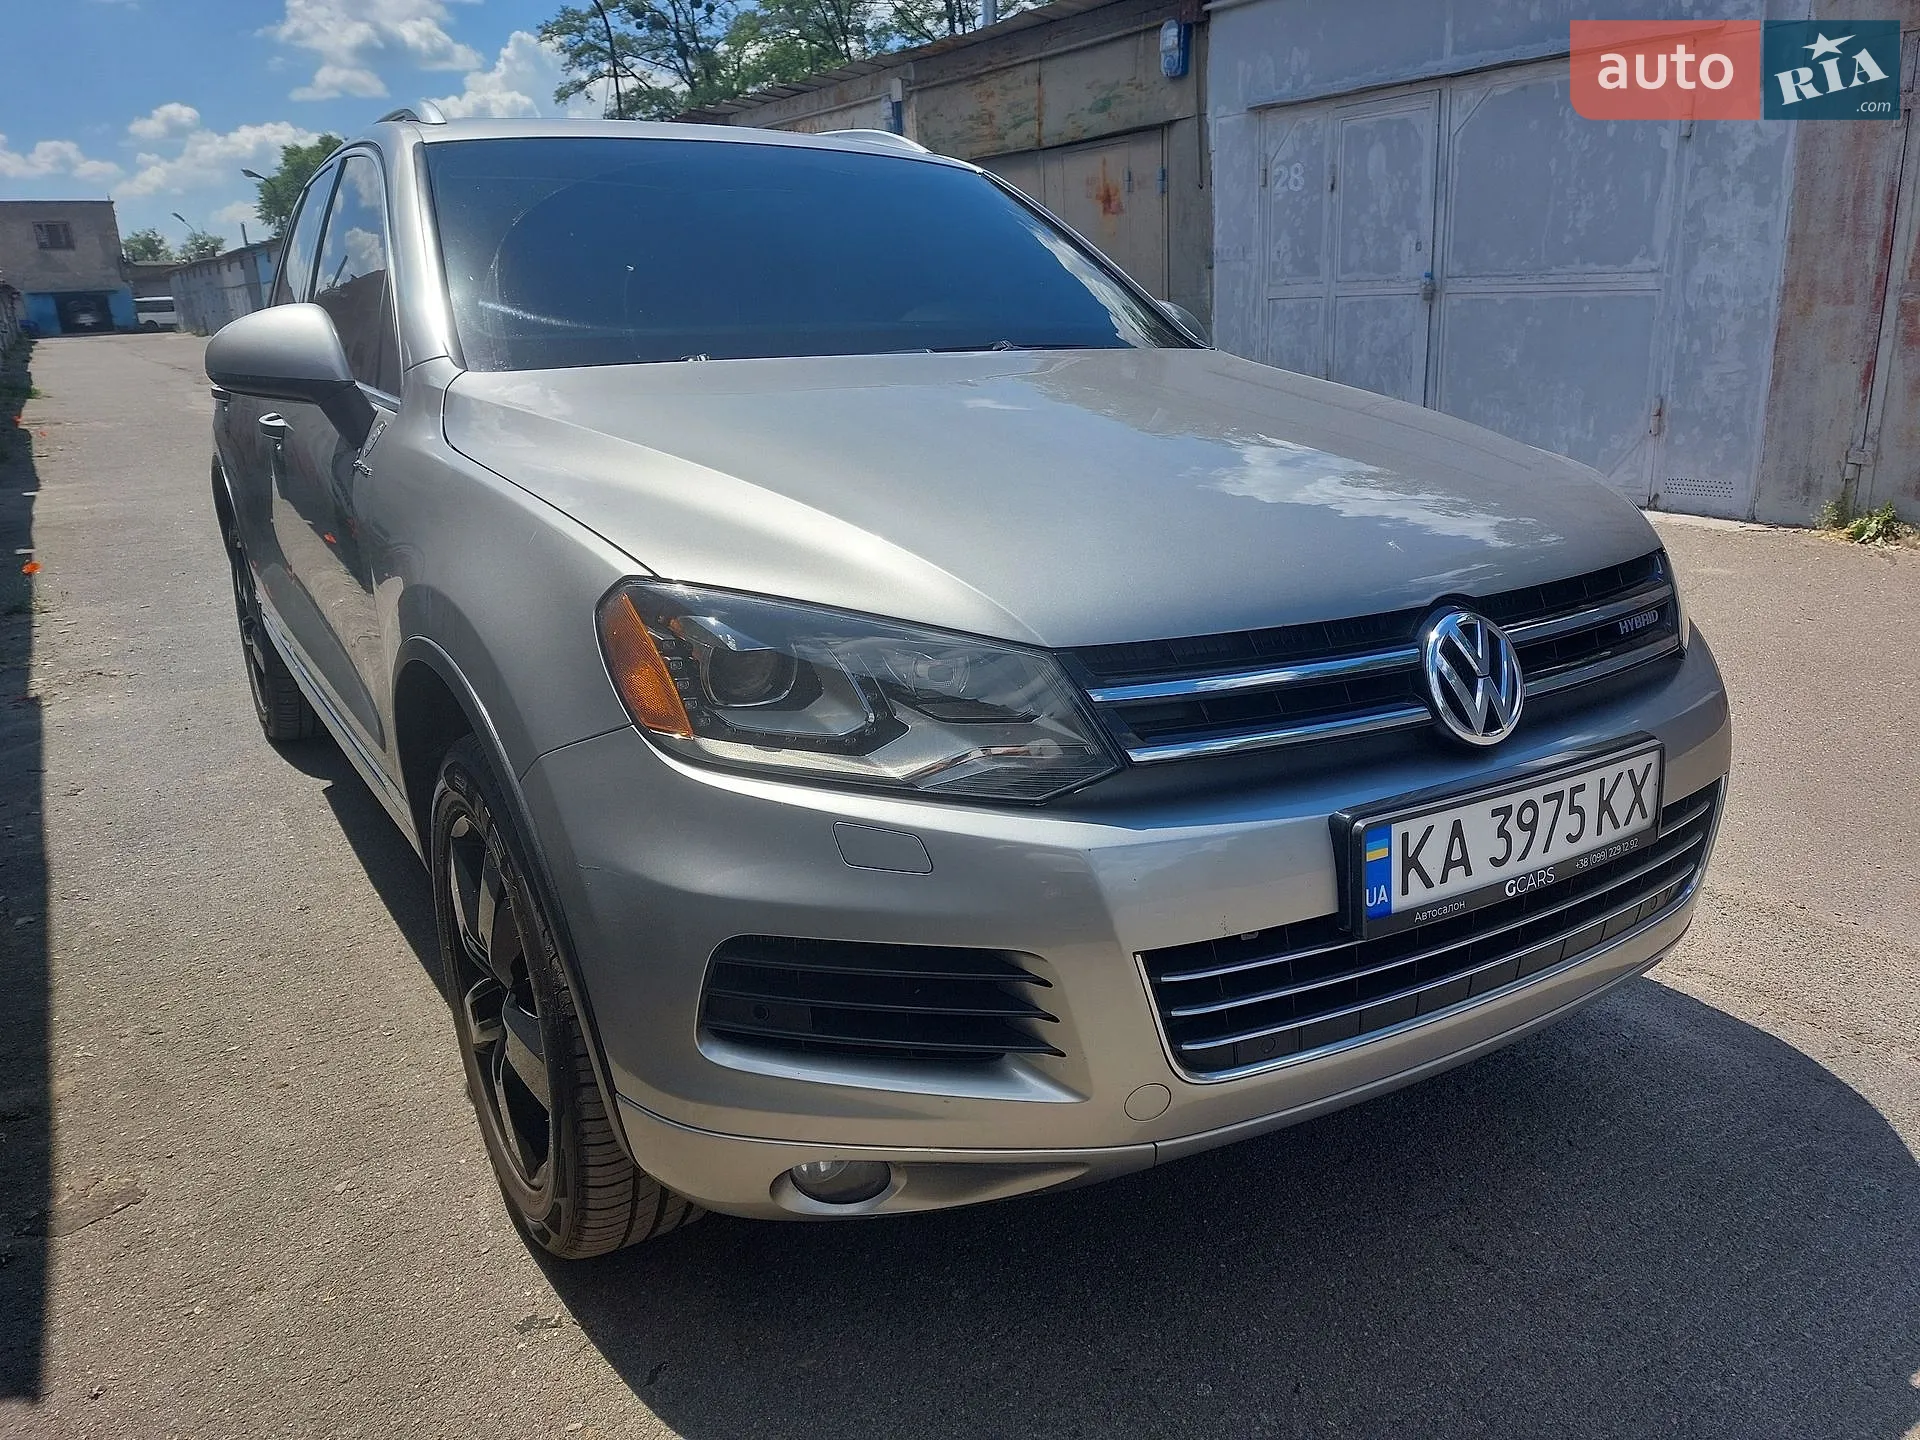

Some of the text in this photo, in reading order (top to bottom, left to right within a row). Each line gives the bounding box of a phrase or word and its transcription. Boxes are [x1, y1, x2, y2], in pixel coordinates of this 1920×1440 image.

[1272, 162, 1305, 194] 28
[1618, 609, 1659, 635] HYBRID
[1400, 763, 1653, 897] KA 3975 KX
[1575, 857, 1589, 869] +38
[1504, 866, 1556, 897] GCARS
[1365, 884, 1389, 908] UA
[1414, 900, 1466, 924] Автосалон
